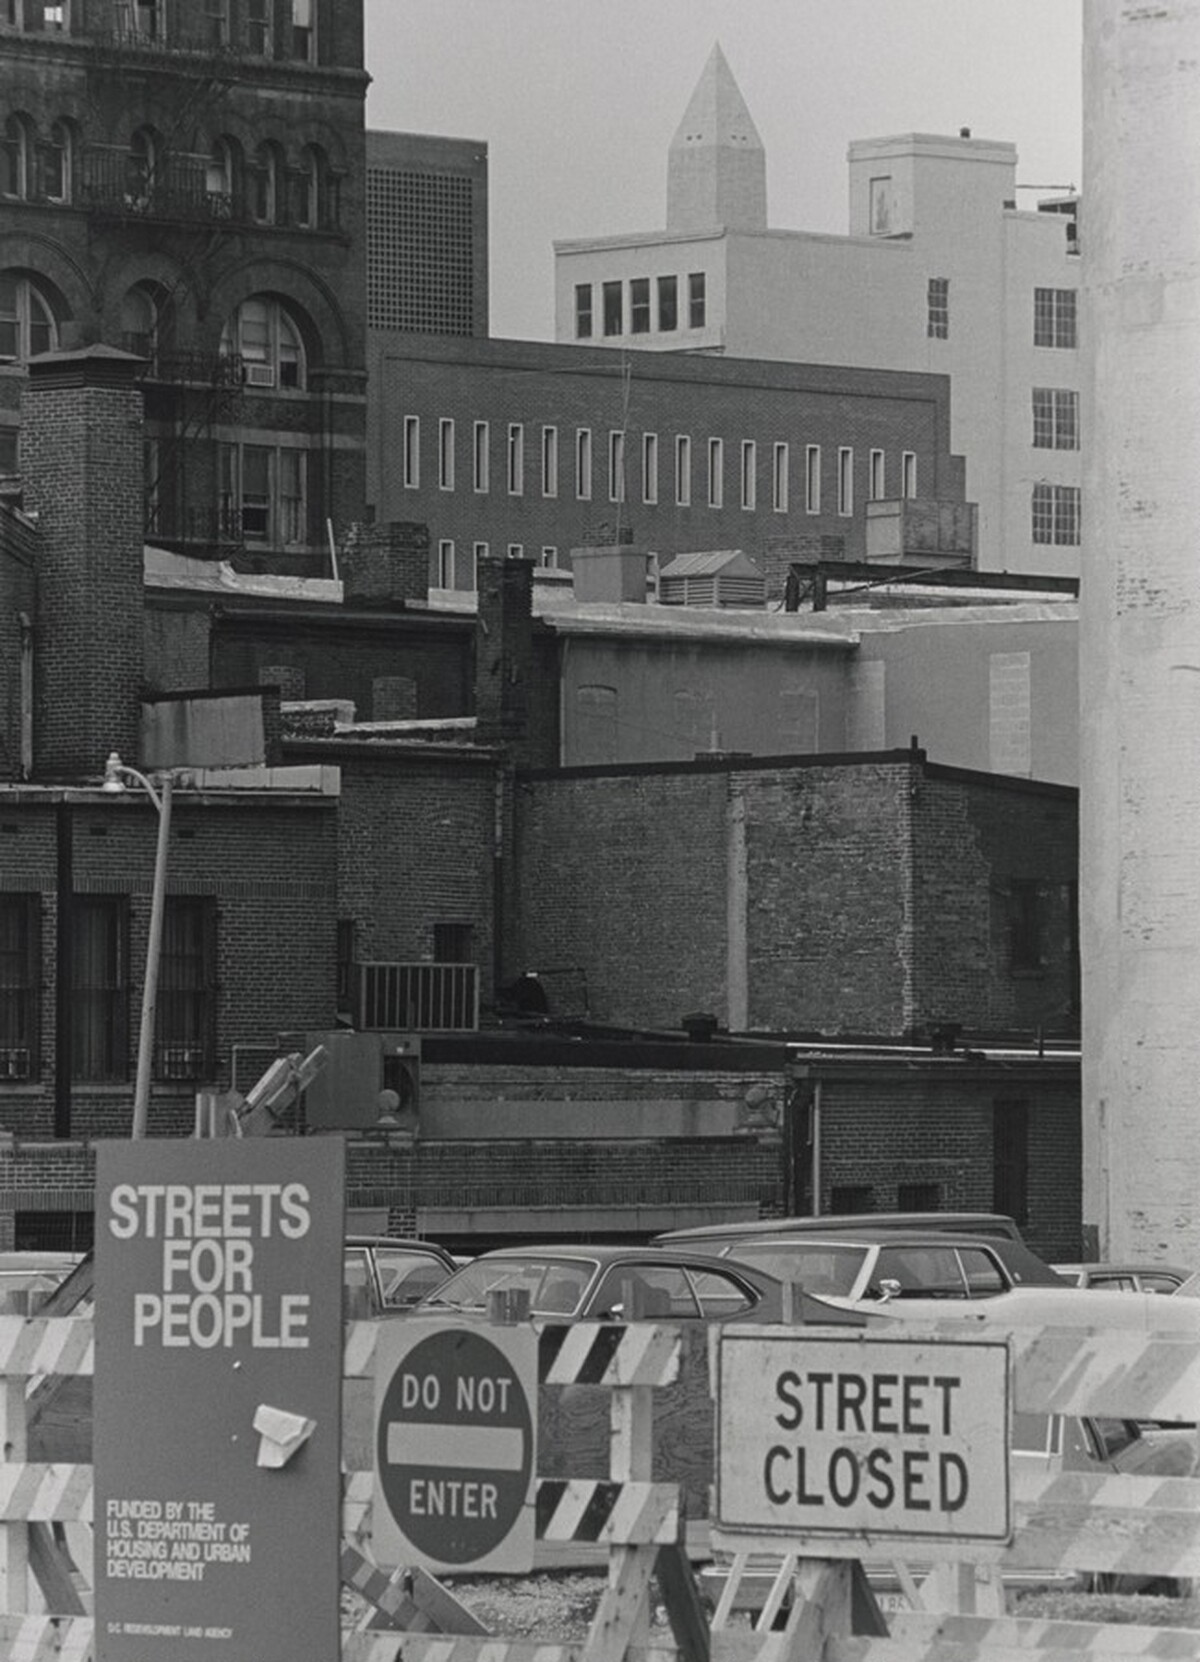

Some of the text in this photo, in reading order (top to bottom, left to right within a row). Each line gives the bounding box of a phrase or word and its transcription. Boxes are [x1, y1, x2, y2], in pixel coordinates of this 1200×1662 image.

[109, 1183, 310, 1239] STREETS
[163, 1239, 253, 1293] FOR
[134, 1293, 310, 1348] PEOPLE
[402, 1374, 512, 1413] DO NOT
[775, 1370, 961, 1436] STREET
[764, 1445, 969, 1512] CLOSED
[107, 1500, 216, 1521] FUNDED BY THE
[410, 1480, 498, 1519] ENTER
[107, 1520, 250, 1542] U.S. DEPARTMENT OF
[107, 1540, 251, 1563] HOUSING AND URBAN
[107, 1560, 206, 1581] DEVELOPMENT
